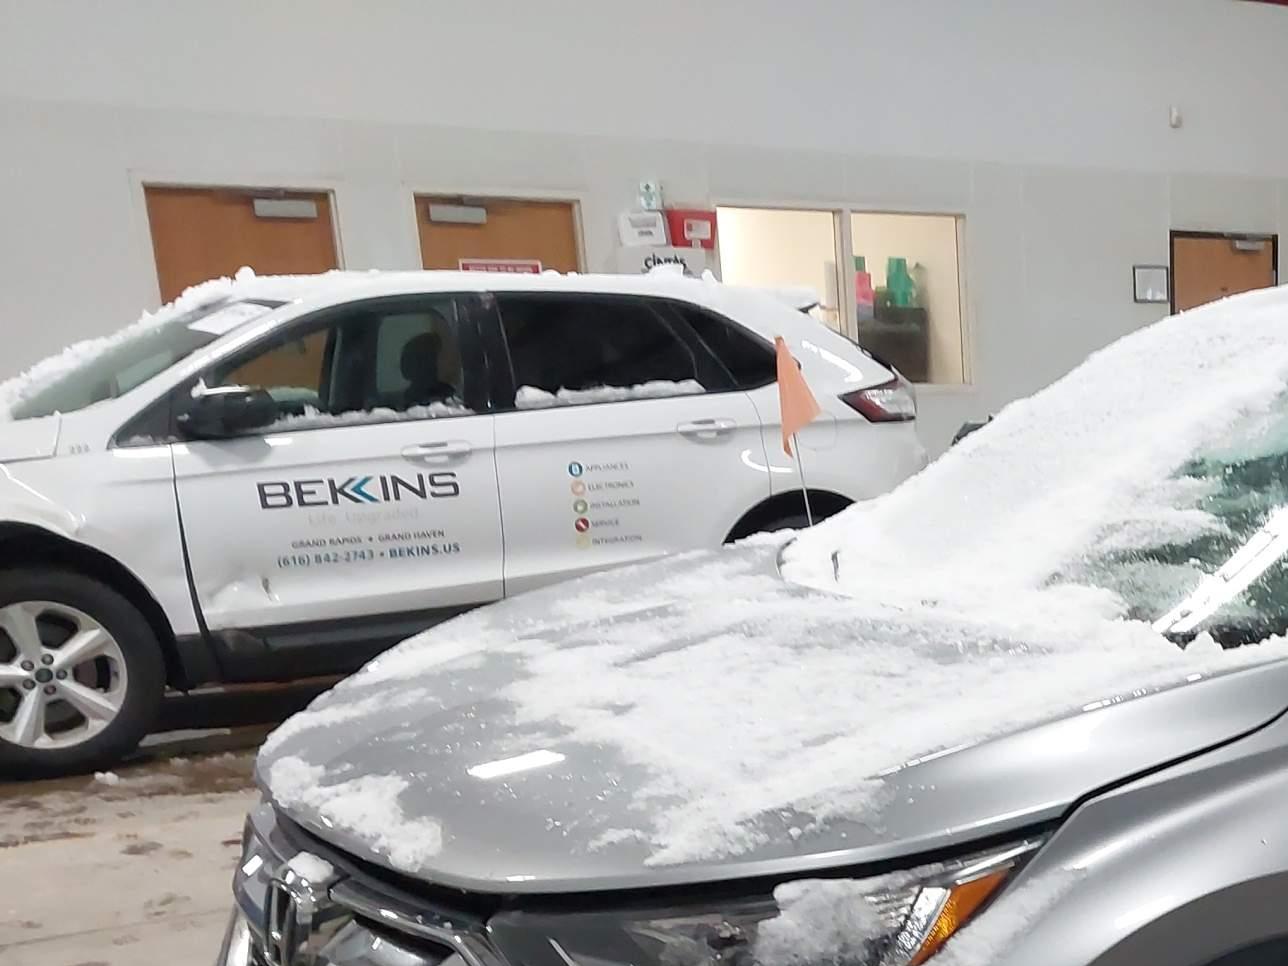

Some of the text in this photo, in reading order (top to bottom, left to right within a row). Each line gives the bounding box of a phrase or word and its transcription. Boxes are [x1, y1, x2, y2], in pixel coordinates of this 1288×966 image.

[256, 471, 461, 510] BEKINS
[587, 480, 635, 491] ELECTRONICS
[291, 529, 446, 548] GRAND RAPIDS GRAND HAVEN
[277, 542, 461, 569] (616) 842-2743 BEKINS.US
